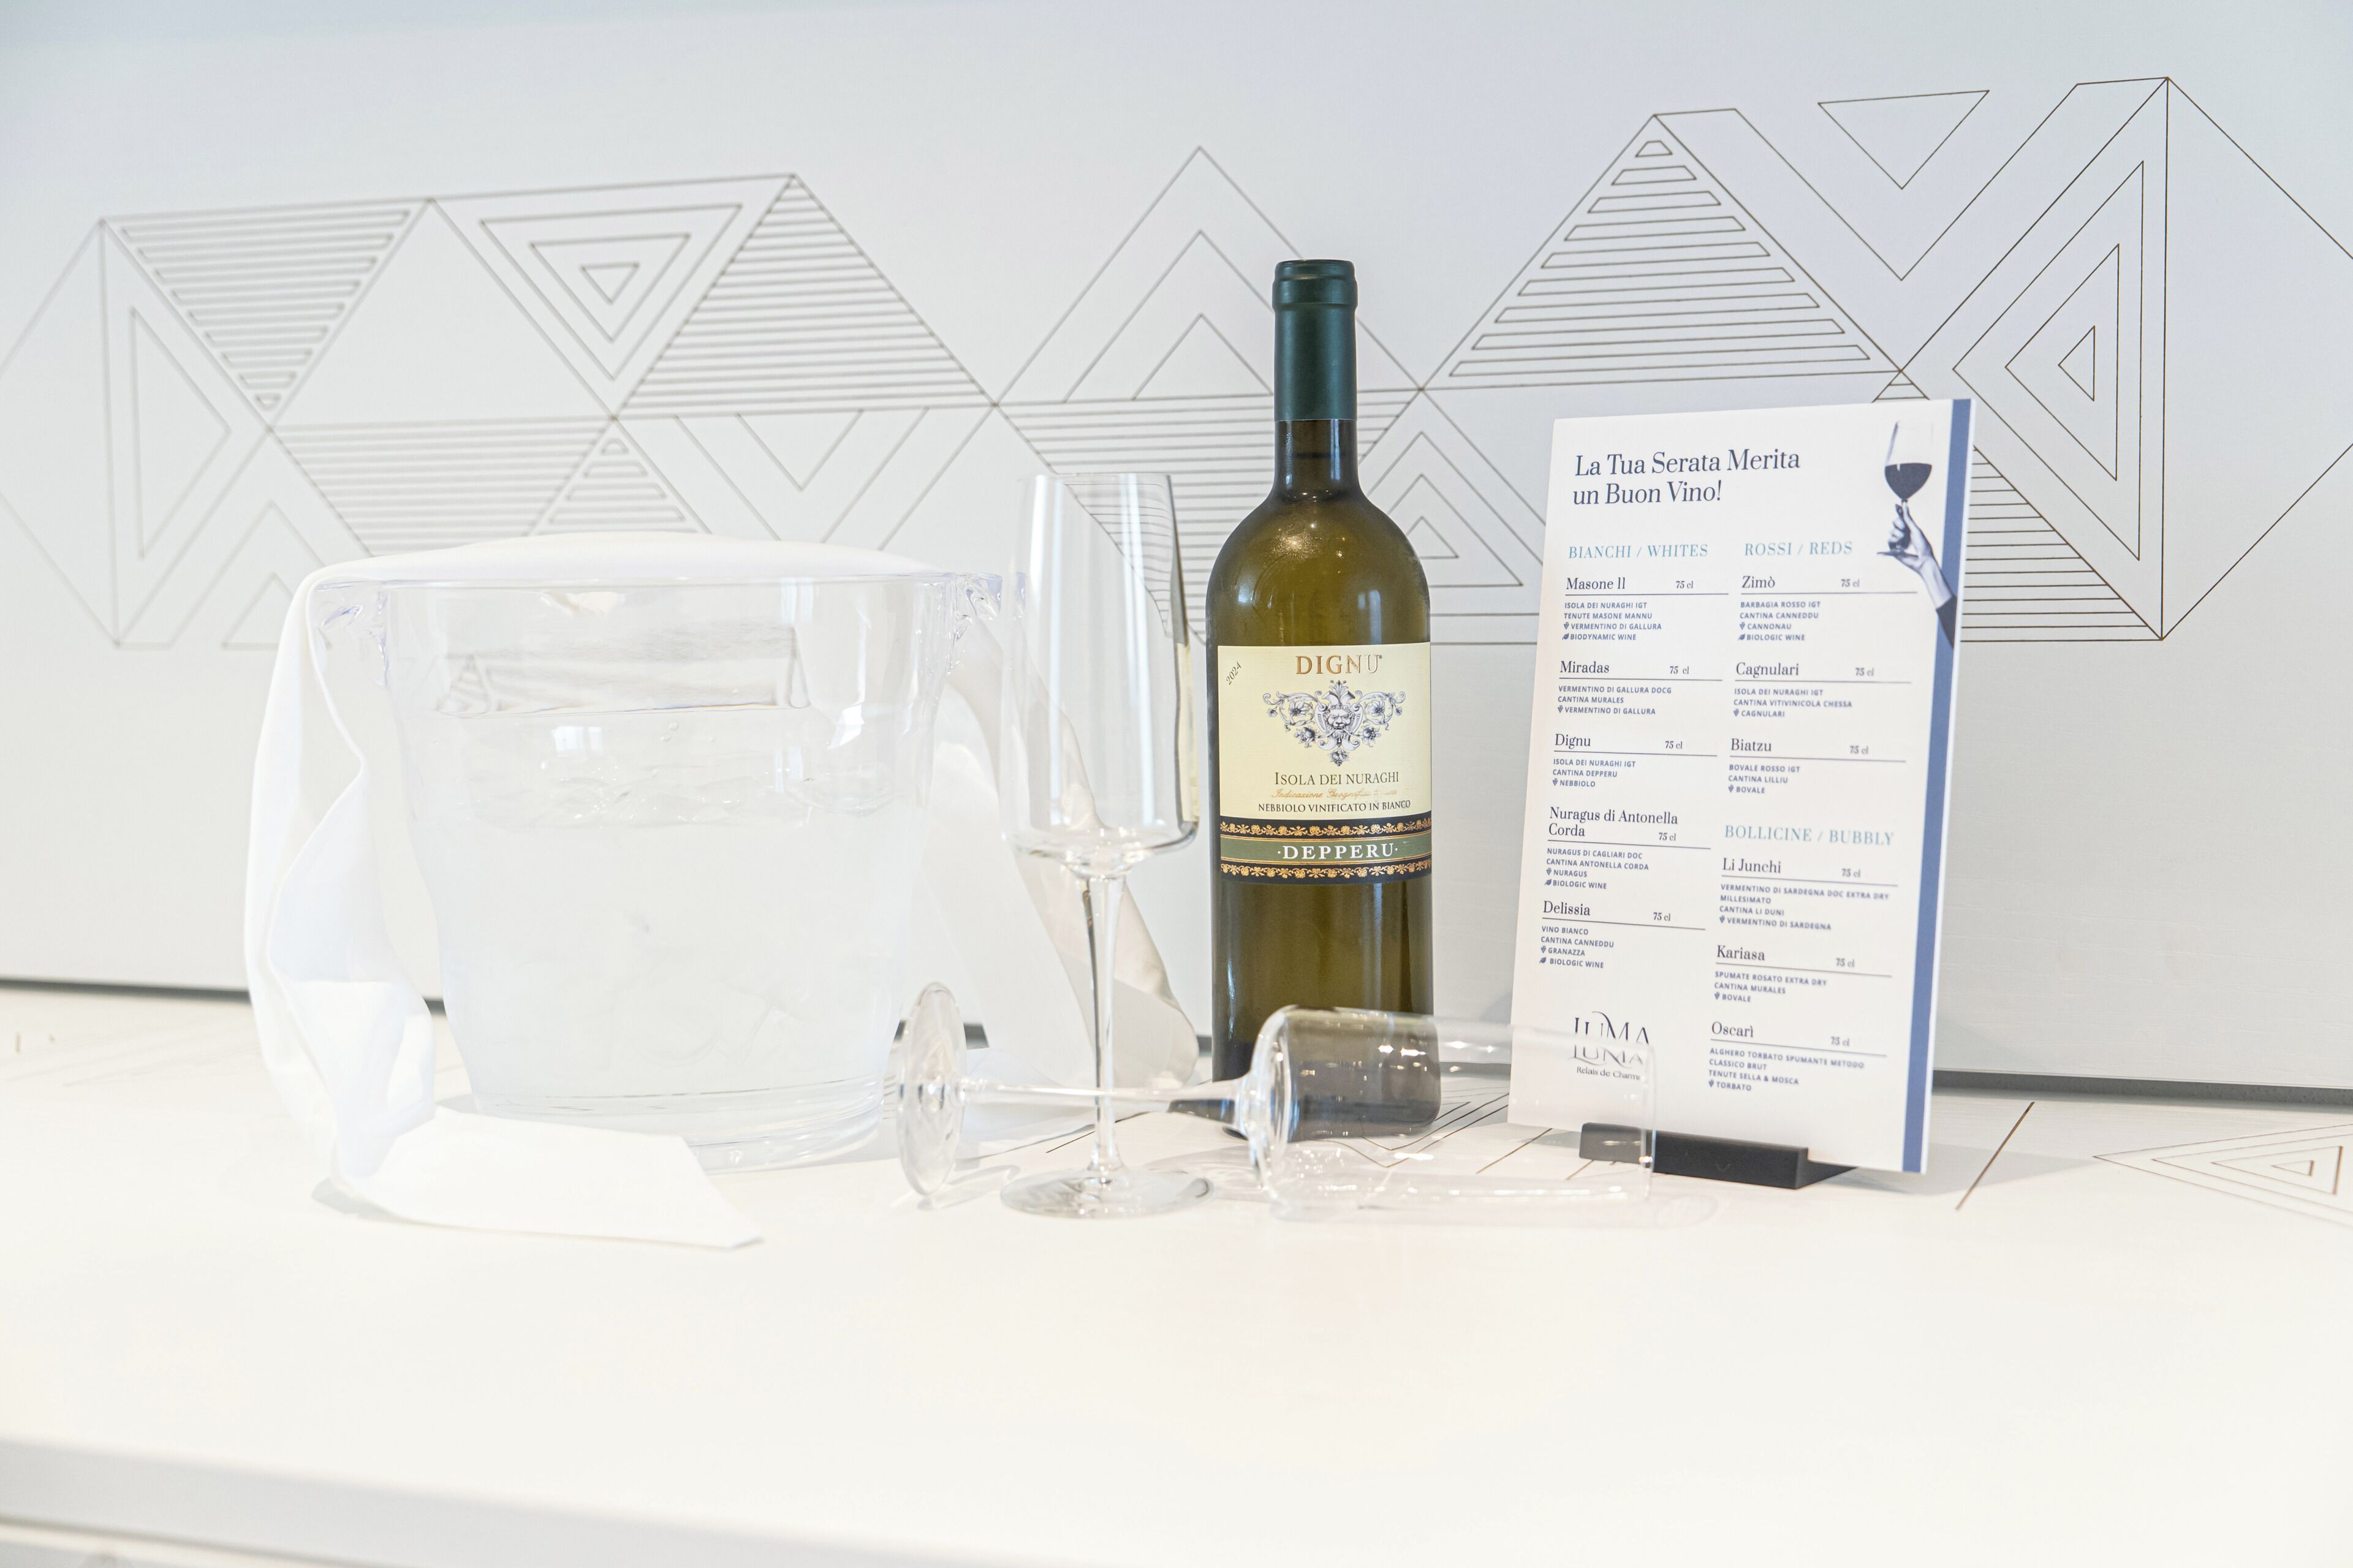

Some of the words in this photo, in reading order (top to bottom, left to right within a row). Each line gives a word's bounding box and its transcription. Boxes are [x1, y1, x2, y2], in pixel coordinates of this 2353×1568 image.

[1575, 455, 1601, 475] La
[1607, 454, 1646, 474] Tua
[1652, 452, 1721, 473] Serata
[1727, 449, 1800, 471] Merita
[1574, 490, 1599, 504] un
[1605, 483, 1661, 504] Buon
[1667, 480, 1721, 502] Vino!
[1569, 546, 1631, 558] BIANCHI
[1648, 544, 1707, 557] WHITES
[1745, 542, 1791, 556] ROSSI
[1809, 542, 1852, 555] REDS
[1566, 578, 1613, 589] Masone
[1742, 576, 1775, 588] Zimò
[1226, 661, 1241, 685] 2024
[1560, 661, 1609, 673] Miradas
[1737, 662, 1798, 678] Cagnulari
[1555, 733, 1590, 749] Dignu
[1731, 738, 1771, 751] Biatzu
[1275, 772, 1315, 785] ISOLA
[1320, 775, 1341, 784] DEI
[1346, 772, 1398, 784] NURAGHI
[1308, 803, 1366, 812] VINIFICATO
[1382, 800, 1411, 809] BIANCO
[1550, 807, 1600, 823] Nuragus
[1604, 809, 1615, 821] di
[1618, 810, 1677, 824] Antonella
[1549, 823, 1585, 836] Corda
[1726, 825, 1811, 841] BOLLICINE
[1829, 830, 1893, 846] BUBBLY
[1659, 832, 1667, 841] 75
[1283, 843, 1395, 861] DEPPERU
[1723, 858, 1734, 871] Li
[1738, 858, 1781, 873] Junchi
[1721, 884, 1770, 893] VERMENTINO
[1720, 895, 1771, 904] MILLESIMATO
[1544, 901, 1590, 915] Delissia
[1727, 917, 1777, 926] VERMENTINO
[1790, 922, 1831, 930] SARDEGNA
[1574, 939, 1613, 948] CANNEDDU
[1548, 947, 1585, 956] GRANAZZA
[1717, 945, 1765, 961] Kariasa
[1715, 971, 1749, 980] SPUMATE
[1752, 974, 1783, 983] ROSATO
[1751, 985, 1786, 994] MURALES
[1712, 1021, 1753, 1037] Oscarì
[1710, 1048, 1745, 1057] ALGHERO
[1748, 1051, 1783, 1061] TORBATO
[1786, 1055, 1827, 1065] SPUMANTE
[1709, 1059, 1745, 1068] CLASSICO
[1709, 1069, 1737, 1078] TENUTE
[1771, 1076, 1798, 1085] MOSCA
[1716, 1081, 1751, 1091] TORBATO
